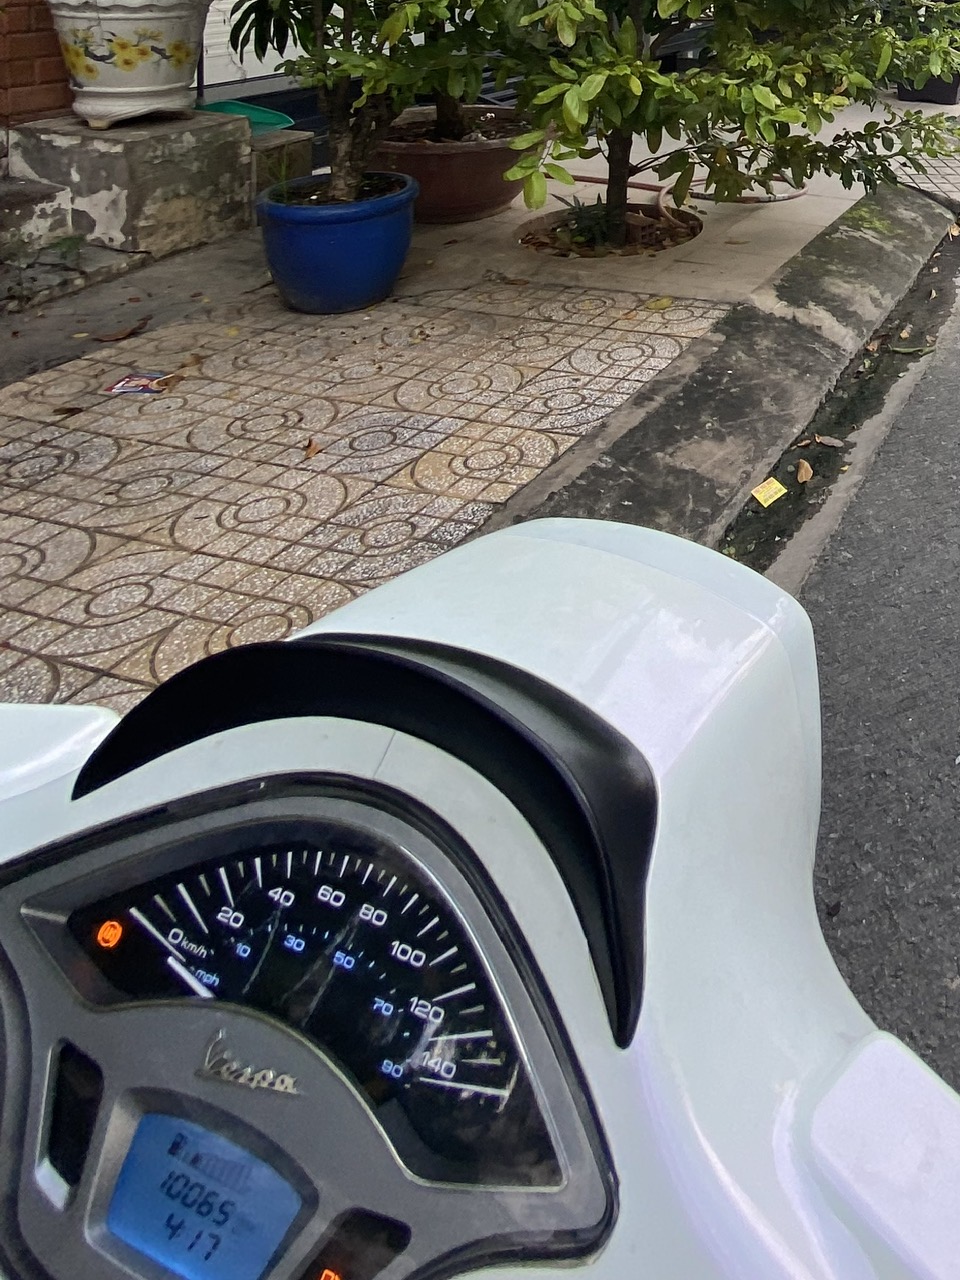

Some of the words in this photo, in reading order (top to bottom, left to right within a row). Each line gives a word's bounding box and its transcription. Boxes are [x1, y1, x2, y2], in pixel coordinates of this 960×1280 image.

[268, 887, 295, 907] 40
[317, 885, 345, 907] 60
[216, 907, 244, 928] 20
[359, 903, 388, 926] 80
[168, 928, 183, 943] 0
[181, 940, 208, 959] km/h
[236, 942, 251, 958] 10
[284, 934, 305, 952] 30
[333, 951, 355, 969] 50
[391, 940, 427, 968] 100
[195, 969, 220, 987] mph
[373, 997, 394, 1016] 70
[409, 996, 445, 1023] 120
[194, 1028, 299, 1094] Vespa
[381, 1059, 403, 1078] 90
[422, 1051, 457, 1079] 140
[160, 1170, 236, 1226] 10065
